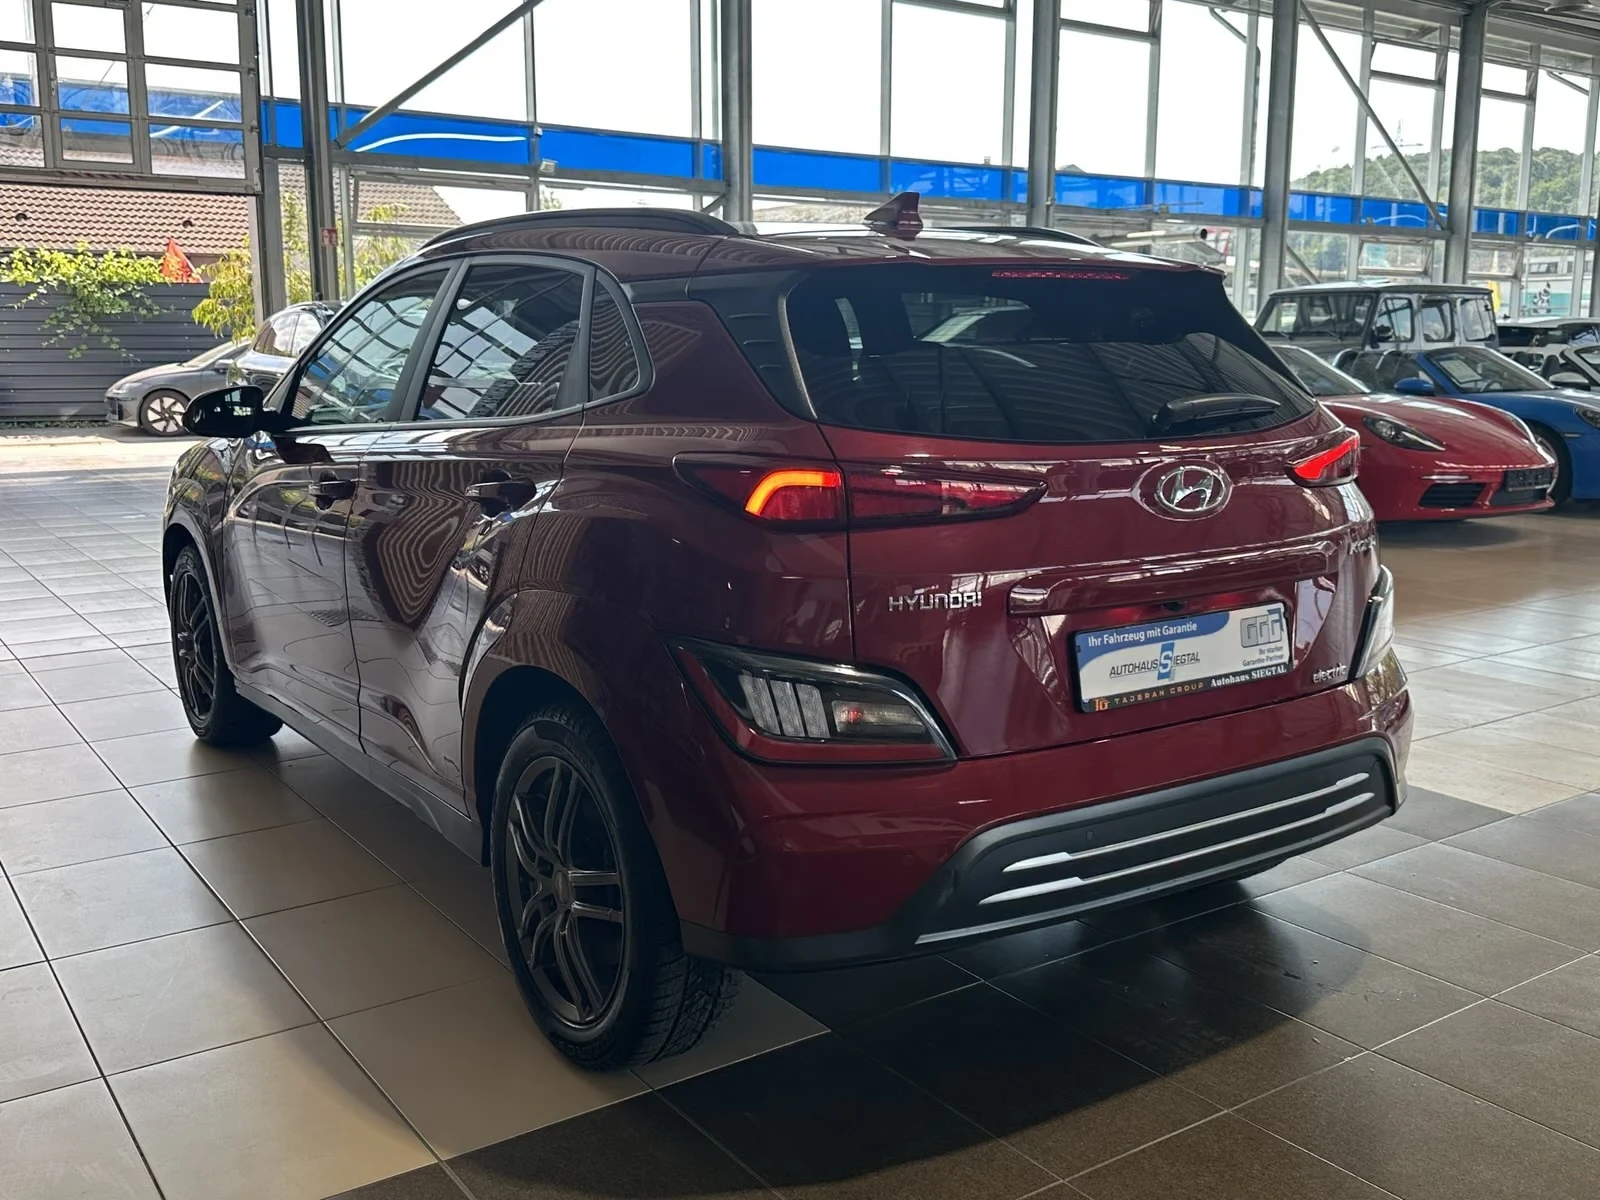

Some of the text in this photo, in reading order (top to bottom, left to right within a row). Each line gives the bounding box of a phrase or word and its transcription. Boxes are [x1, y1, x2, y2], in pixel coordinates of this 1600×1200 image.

[888, 591, 982, 611] HYUNDAI
[1088, 621, 1198, 647] Ihr Fahrzeug mit Garantie
[1109, 650, 1201, 677] AUTOHAUS SIEGTAL
[1313, 663, 1347, 684] electric
[1210, 664, 1287, 688] Autohaus SIEGTAL
[1169, 682, 1204, 694] GROUP
